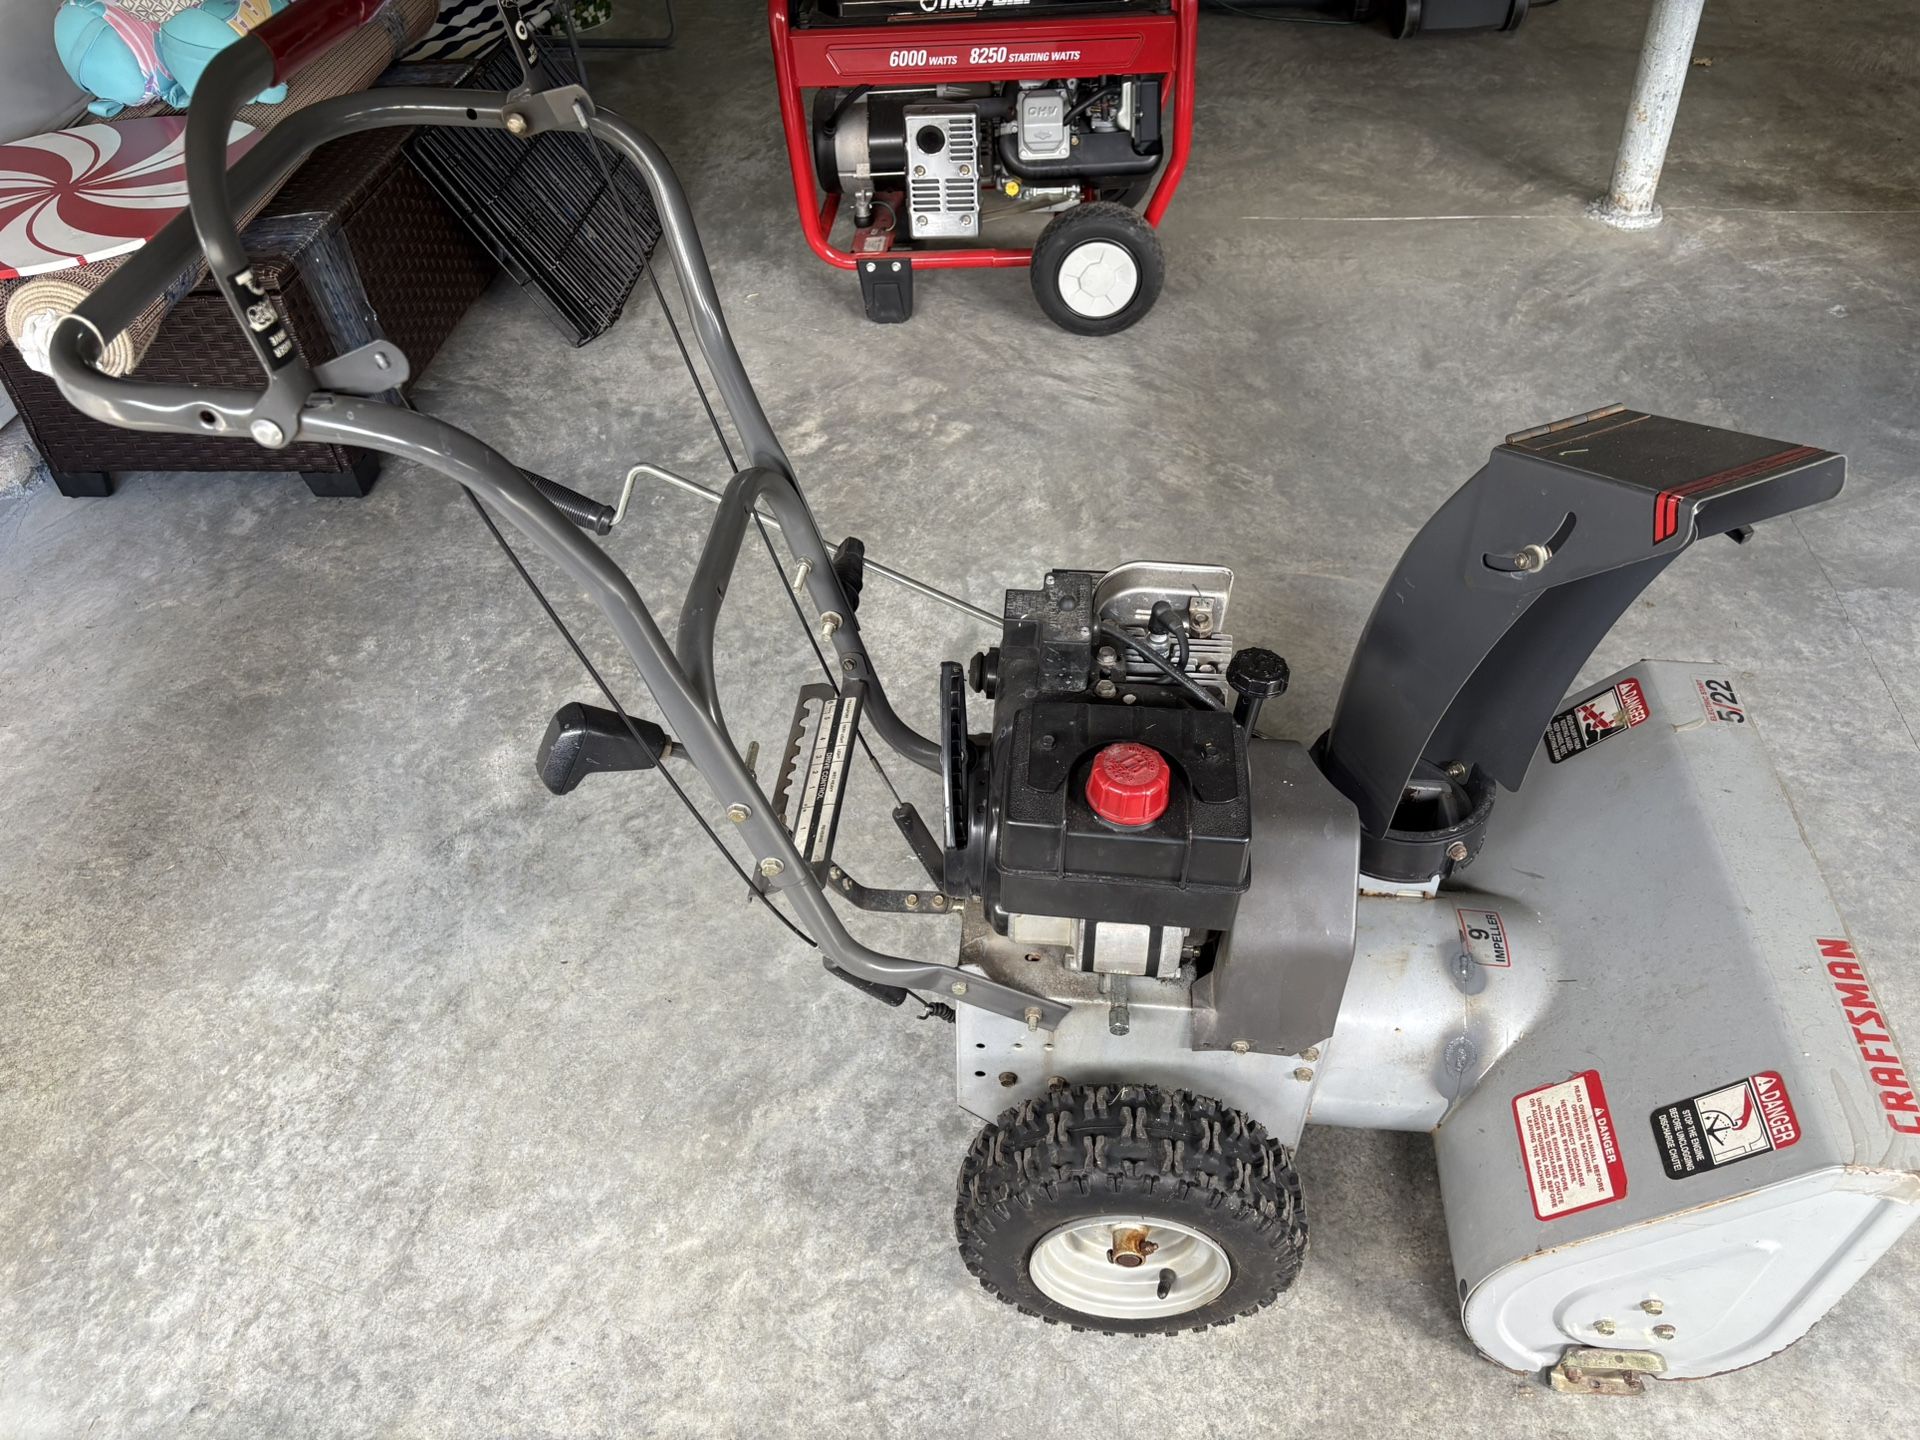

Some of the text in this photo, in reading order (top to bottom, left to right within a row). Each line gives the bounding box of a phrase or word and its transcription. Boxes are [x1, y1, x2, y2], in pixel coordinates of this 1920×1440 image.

[889, 47, 1081, 68] 6000 WATTS 8250 STARTING WATTS
[1622, 690, 1646, 724] DANGER
[1705, 679, 1744, 723] 5/22
[817, 752, 832, 800] DRIVE CONTROL
[1485, 914, 1506, 962] IMPELLER
[1816, 937, 1920, 1135] CRAFTSMAN
[1530, 1098, 1535, 1108] OR
[1532, 1109, 1541, 1131] AUGER
[1761, 1091, 1795, 1144] DANGER
[1526, 1116, 1536, 1143] LEAVING
[1536, 1159, 1547, 1193] MACHINE.
[1536, 1098, 1564, 1204] UNCLOGGING DISCHARGE CHUTE
[1537, 1132, 1548, 1163] HOUSING
[1545, 1105, 1553, 1121] STOP
[1553, 1137, 1562, 1162] ENGINE
[1559, 1163, 1569, 1191] BEFORE
[1555, 1107, 1577, 1184] TOWARDS BYSTANDERS.
[1561, 1099, 1586, 1187] NEVER DIRECT DISCHARGE
[1571, 1104, 1592, 1176] OPERATING MACHINE.
[1574, 1085, 1604, 1192] READ OWNERS MANUAL BEFORE
[1597, 1118, 1617, 1163] DANGER
[1659, 1114, 1682, 1172] DISCHARGE CHUTE!
[1669, 1107, 1694, 1171] BEFORE UNCLOGGING
[1682, 1109, 1704, 1162] STOP THE ENGINE
[1548, 1180, 1558, 1208] BEFORE
